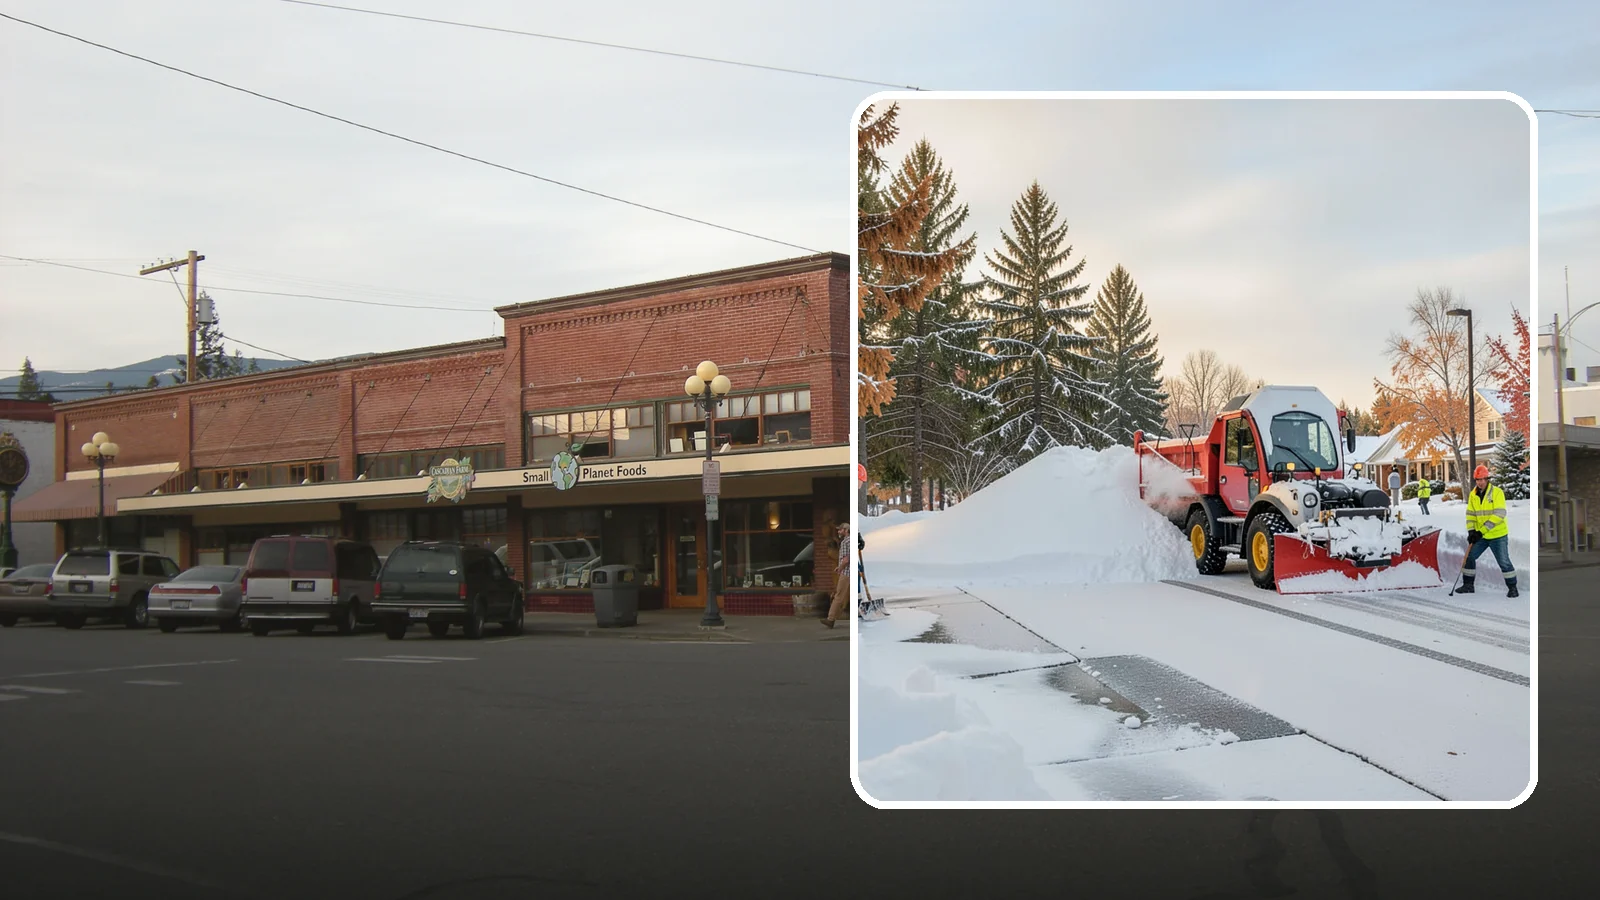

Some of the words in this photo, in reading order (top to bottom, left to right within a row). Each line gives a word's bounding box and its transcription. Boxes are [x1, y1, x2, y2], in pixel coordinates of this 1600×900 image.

[523, 471, 549, 483] Small
[582, 467, 614, 479] Planet
[616, 464, 647, 477] Foods
